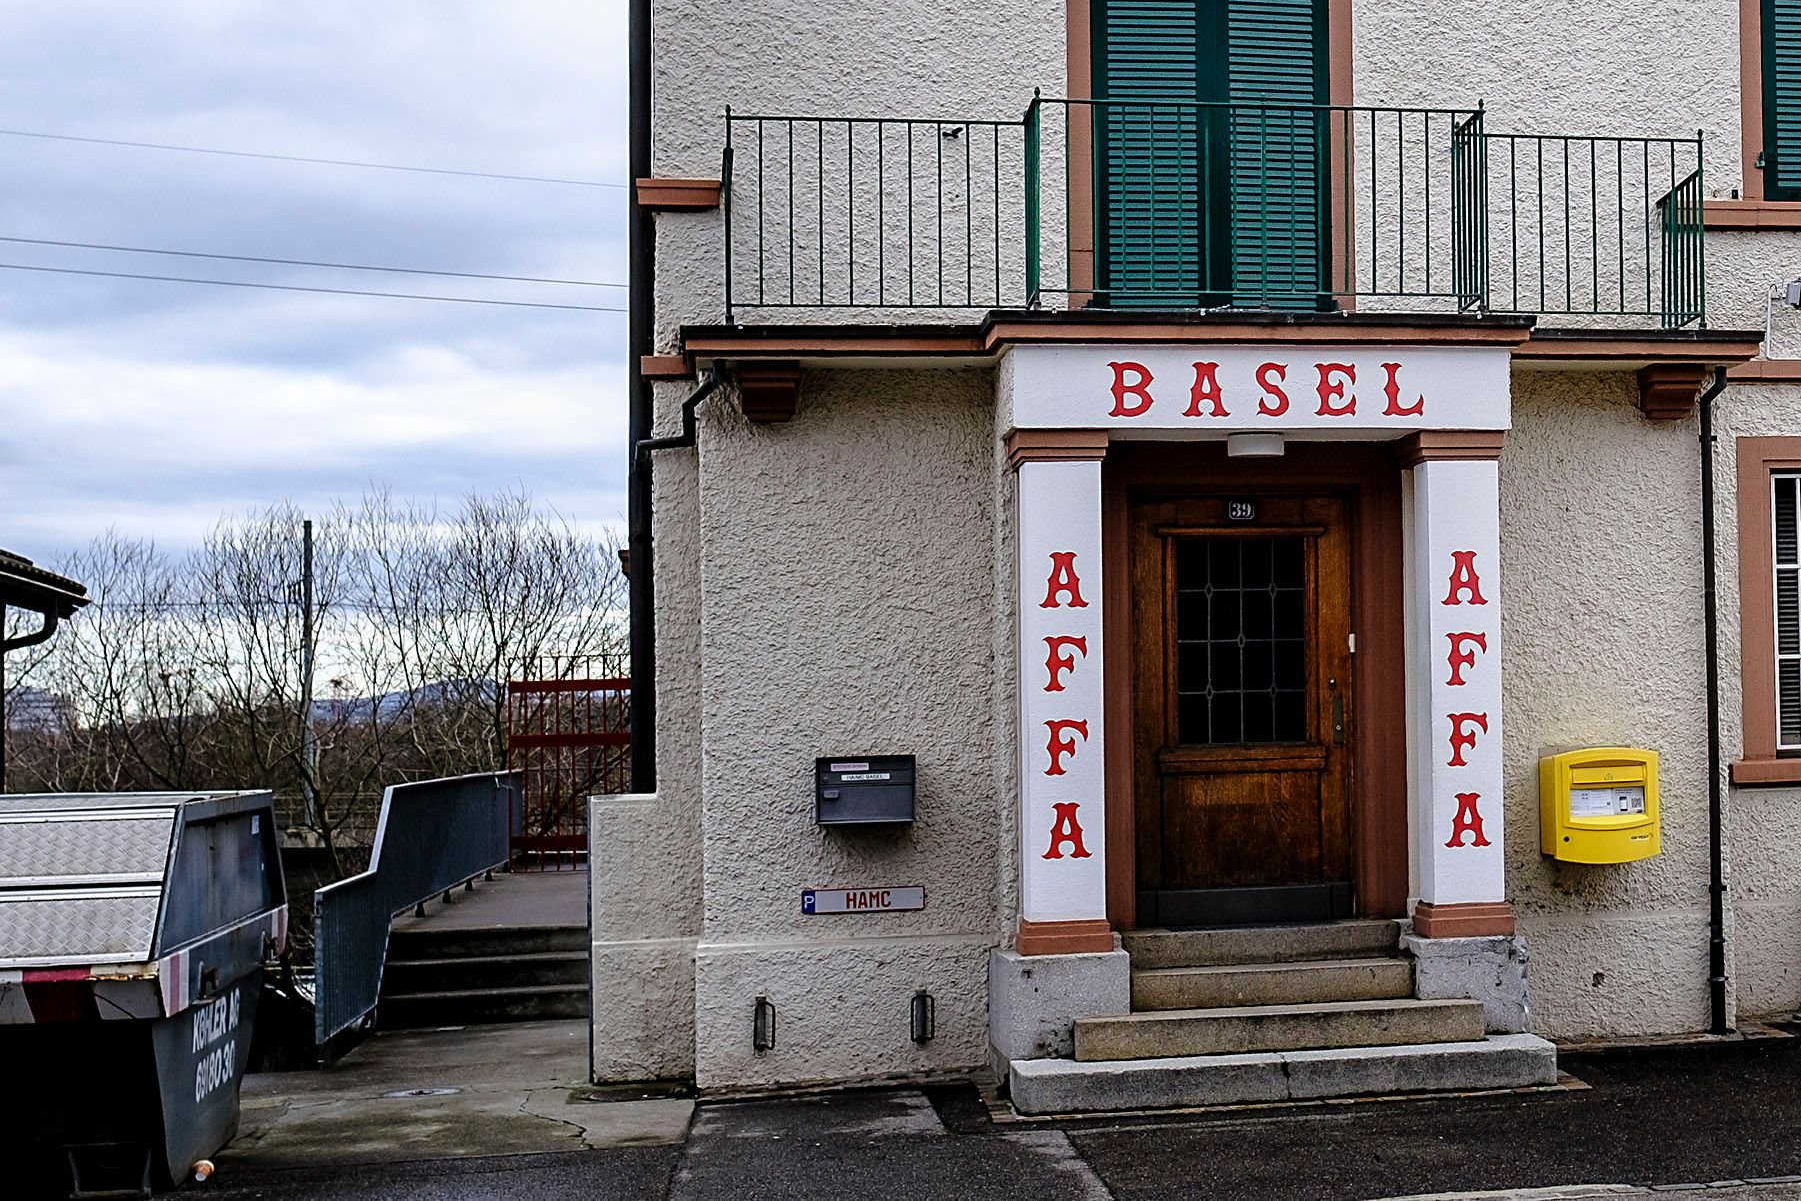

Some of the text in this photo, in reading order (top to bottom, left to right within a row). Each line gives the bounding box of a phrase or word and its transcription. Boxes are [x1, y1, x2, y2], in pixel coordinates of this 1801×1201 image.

[1109, 361, 1424, 417] BASEL
[1231, 502, 1252, 518] 39
[1041, 552, 1090, 860] AFFA
[1443, 550, 1489, 848] AFFA
[845, 890, 892, 910] HAMC
[192, 987, 240, 1054] KOHLER AG
